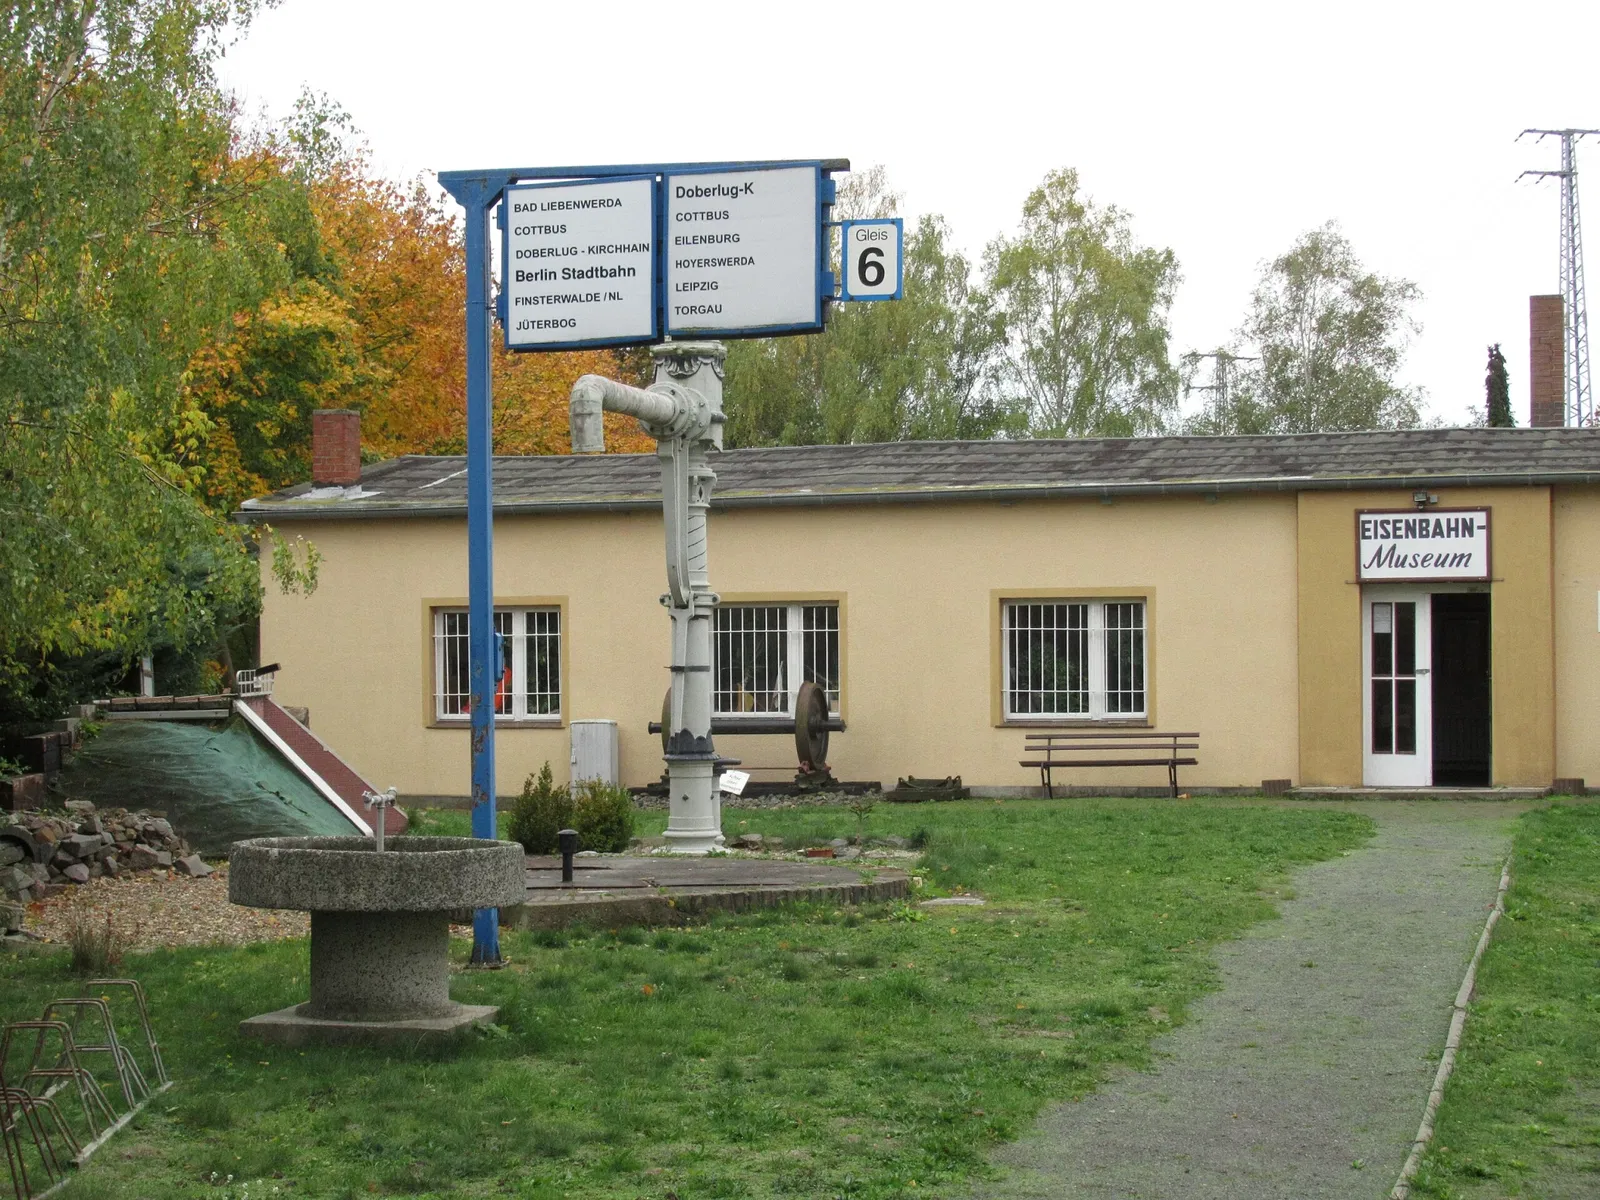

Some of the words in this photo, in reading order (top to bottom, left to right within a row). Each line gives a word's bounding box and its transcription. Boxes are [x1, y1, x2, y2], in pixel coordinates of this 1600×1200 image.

[675, 181, 754, 199] Doberlug-K
[514, 203, 538, 213] BAD
[540, 198, 623, 212] LIEBENWERDA
[675, 210, 730, 222] COTTBUS
[514, 224, 567, 236] COTTBUS
[855, 228, 889, 241] Gleis
[674, 233, 741, 246] EILENBURG
[515, 246, 578, 260] DOBERLUG
[587, 242, 650, 255] KIRCHHAIN
[675, 256, 755, 269] HOYERSWERDA
[857, 246, 886, 287] 6
[515, 268, 557, 283] Berlin
[561, 265, 636, 280] Stadtbahn
[675, 281, 719, 292] LEIPZIG
[515, 292, 601, 307] FINSTERWALDE
[674, 304, 723, 316] TORGAU
[515, 318, 577, 331] JÜTERBOG
[1361, 517, 1486, 540] EISENBAHN-
[1363, 543, 1473, 569] Museum
